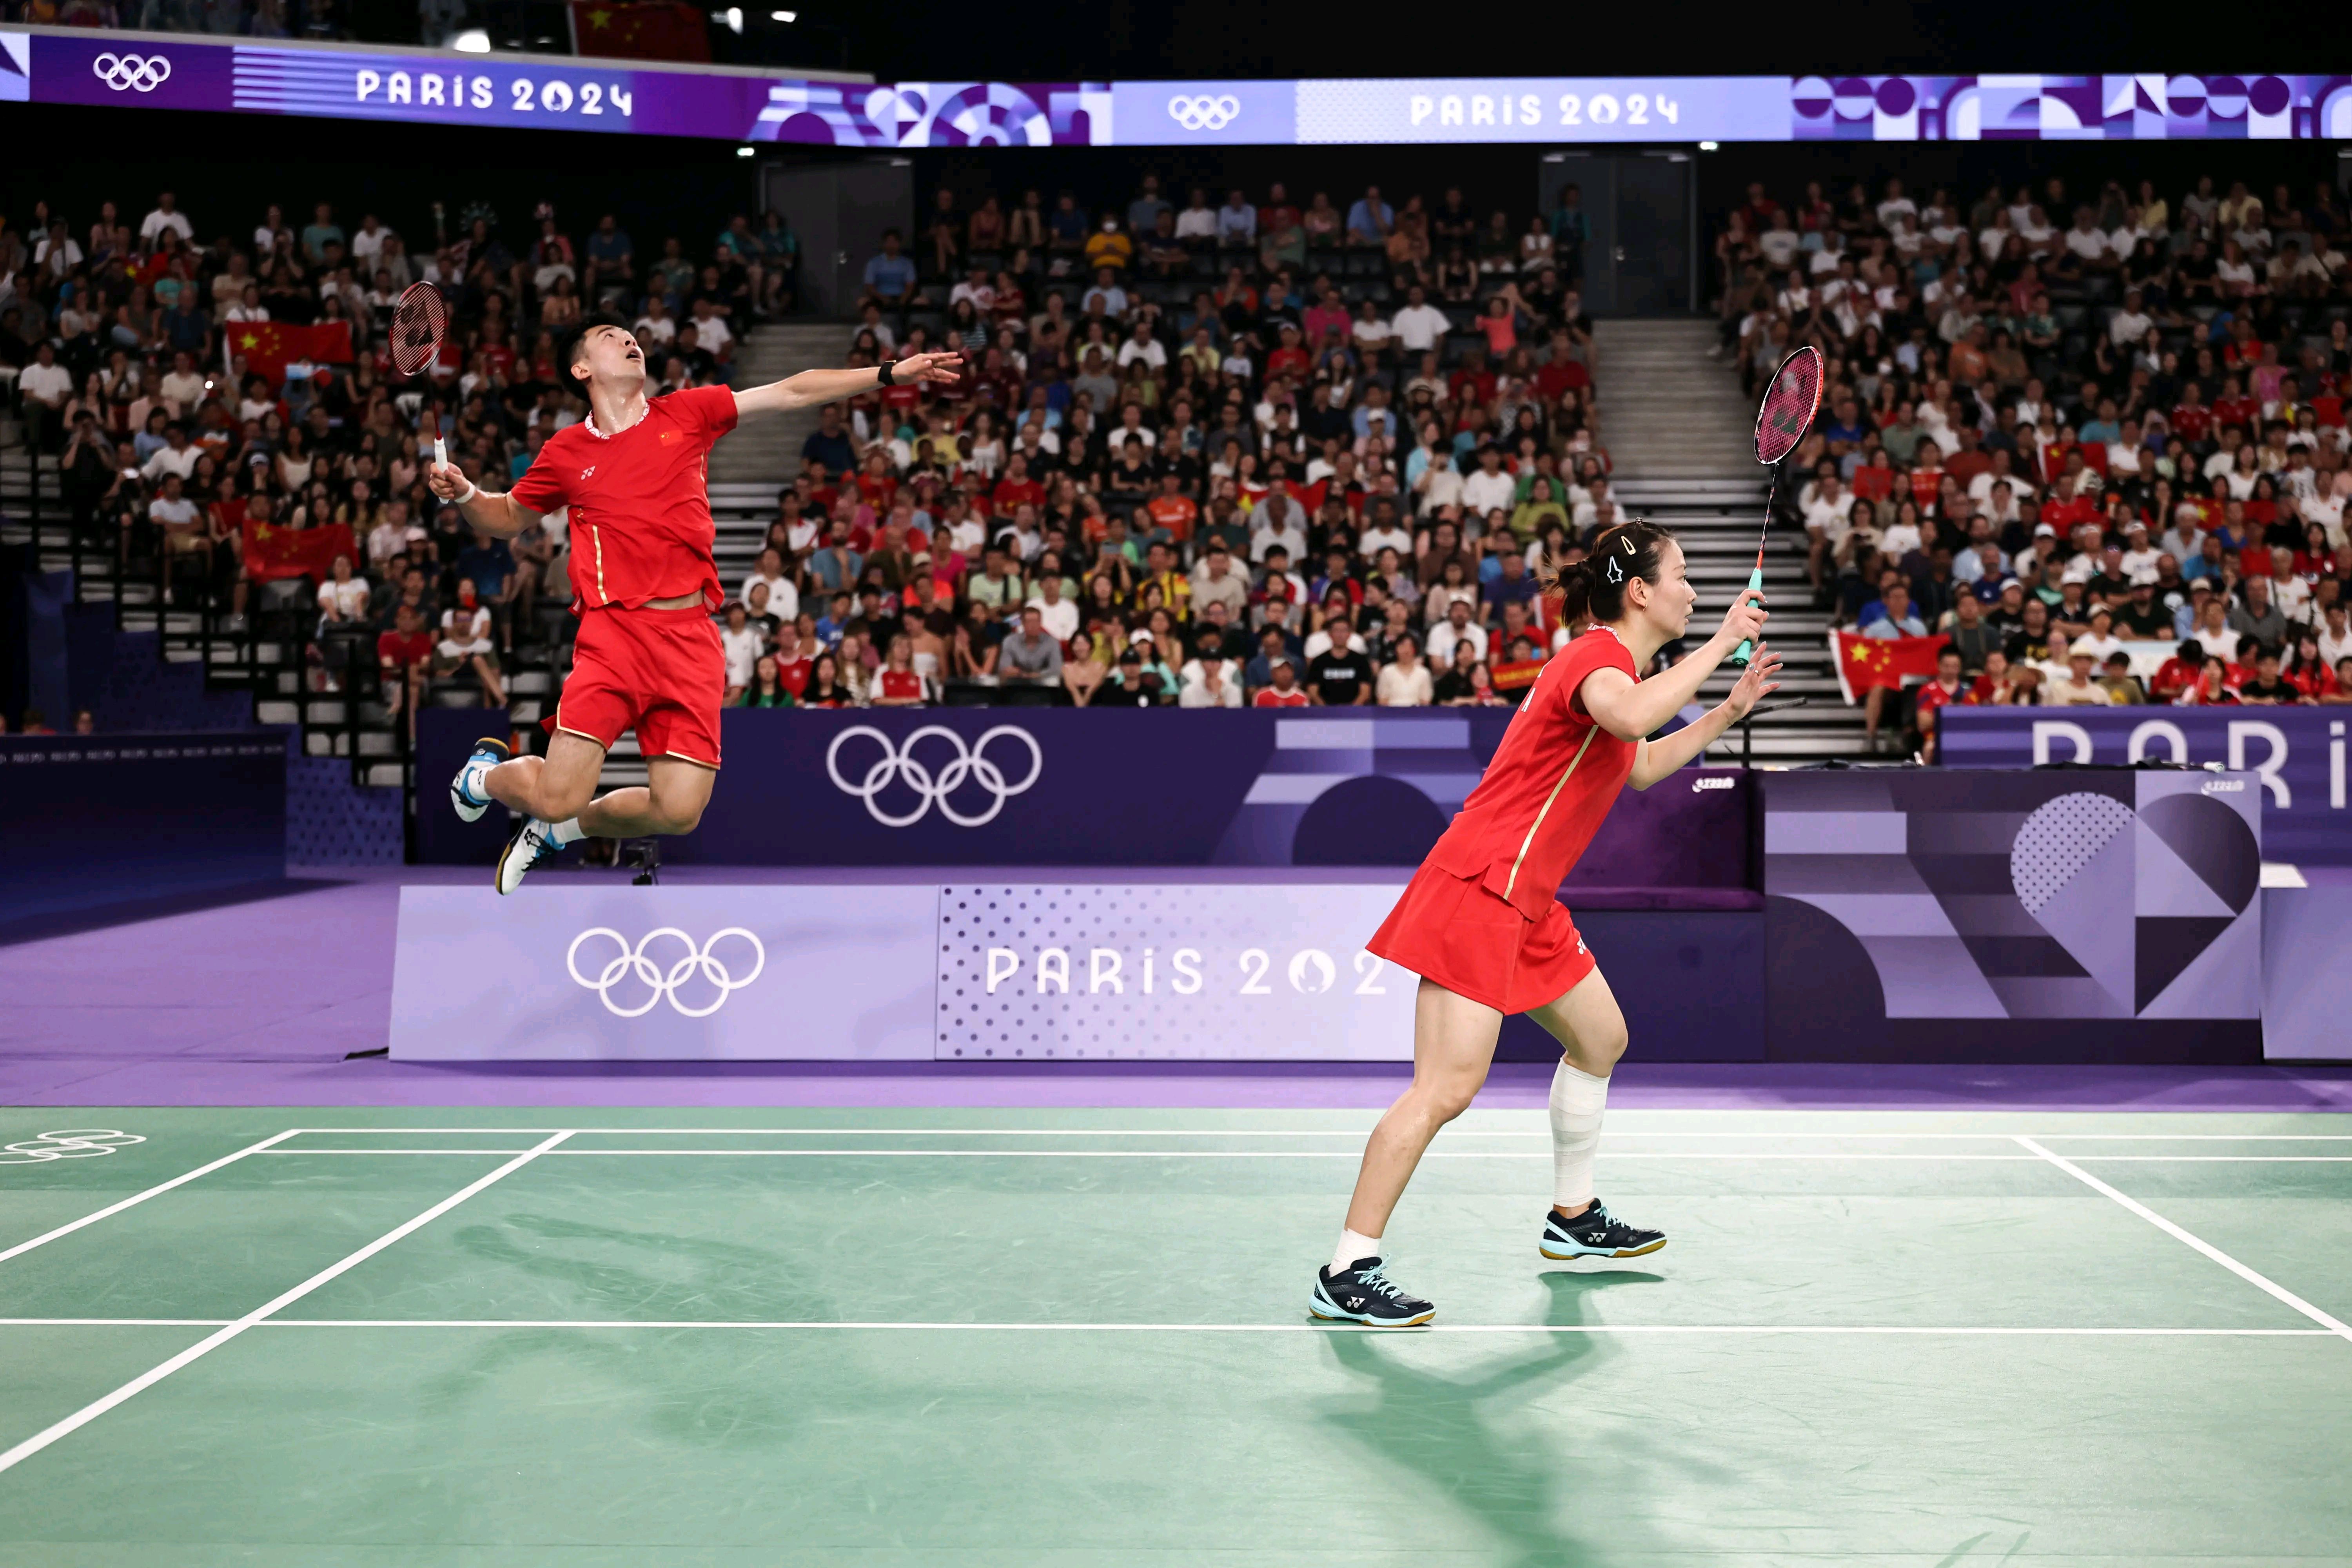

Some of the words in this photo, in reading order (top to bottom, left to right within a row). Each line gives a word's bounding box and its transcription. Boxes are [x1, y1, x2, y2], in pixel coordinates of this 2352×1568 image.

[511, 78, 633, 116] 2024
[1559, 94, 1679, 125] 2024
[1239, 948, 1421, 995] 202
